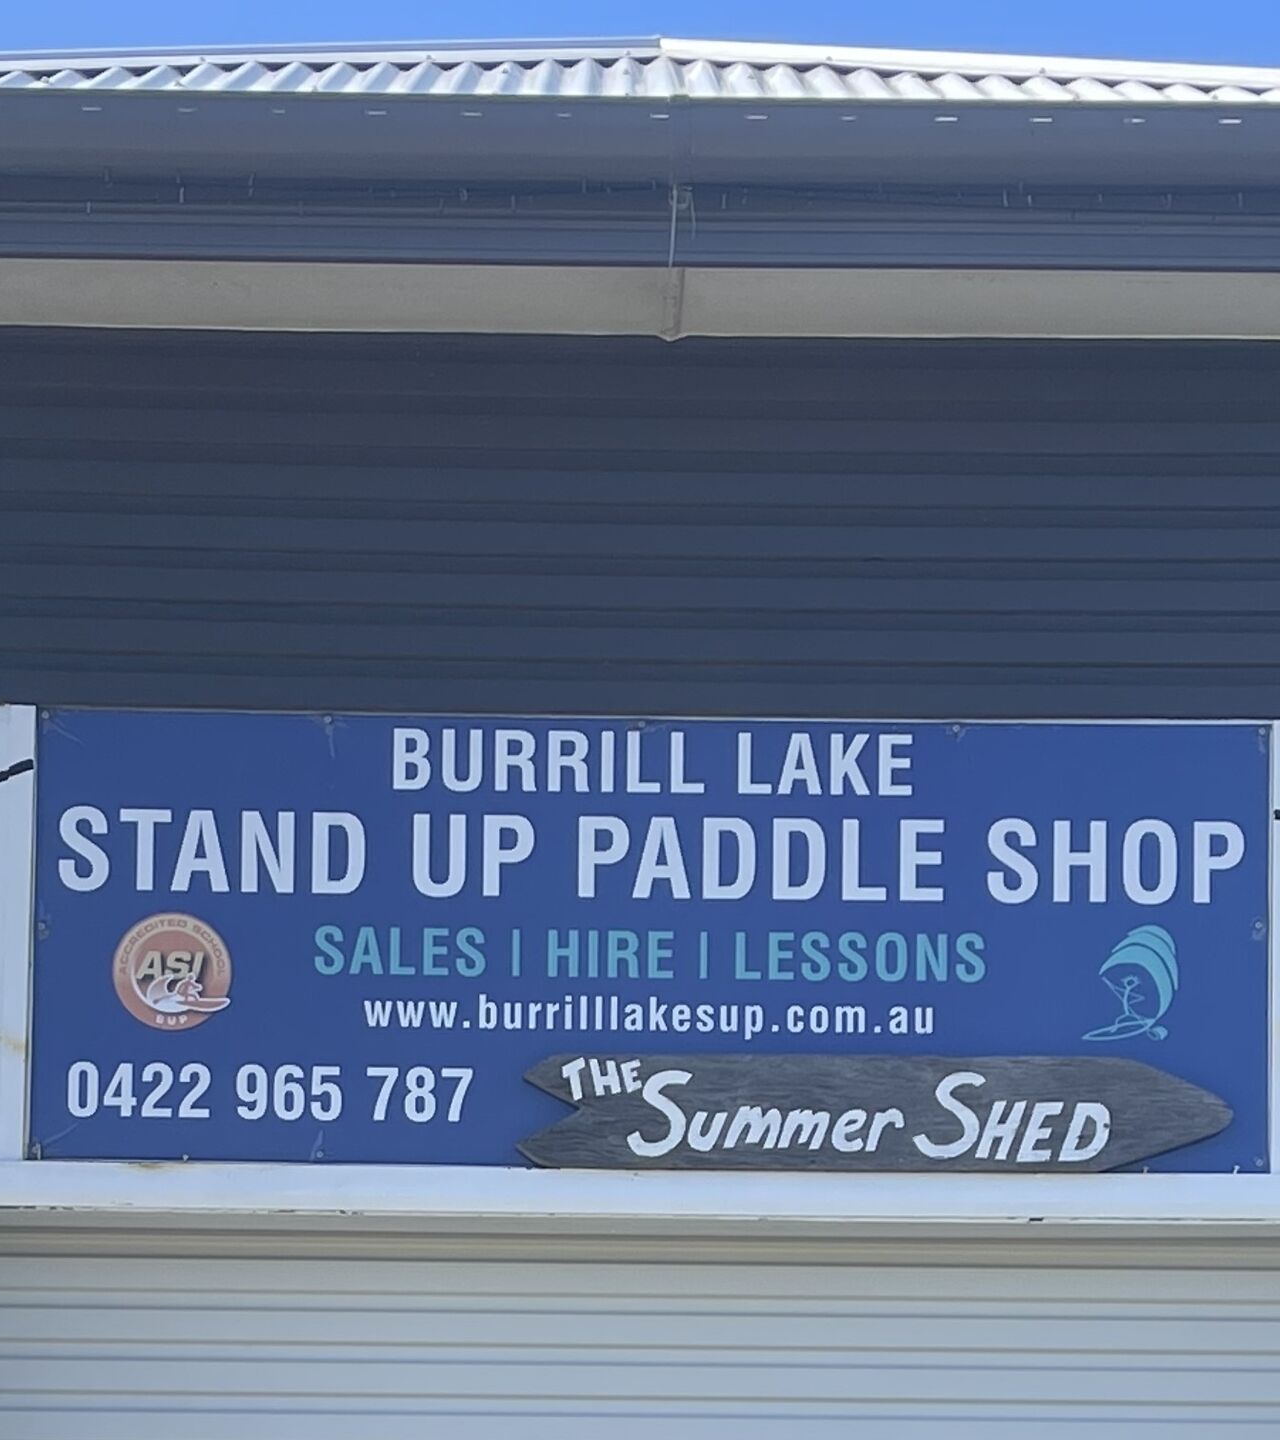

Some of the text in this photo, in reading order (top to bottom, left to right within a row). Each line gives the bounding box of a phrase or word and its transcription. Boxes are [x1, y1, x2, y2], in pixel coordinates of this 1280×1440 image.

[392, 727, 913, 797] BURRILL LAKE
[58, 806, 1246, 905] STAND UP PADDLE SHOP
[136, 950, 205, 981] ASI
[313, 925, 486, 977] SALES
[547, 930, 674, 978] HIRE
[735, 931, 987, 983] LESSONS
[364, 994, 935, 1040] www.burrilllakesup.com.au
[67, 1061, 474, 1122] 0422 965 787
[561, 1057, 642, 1101] THE
[913, 1071, 1111, 1162] SHED
